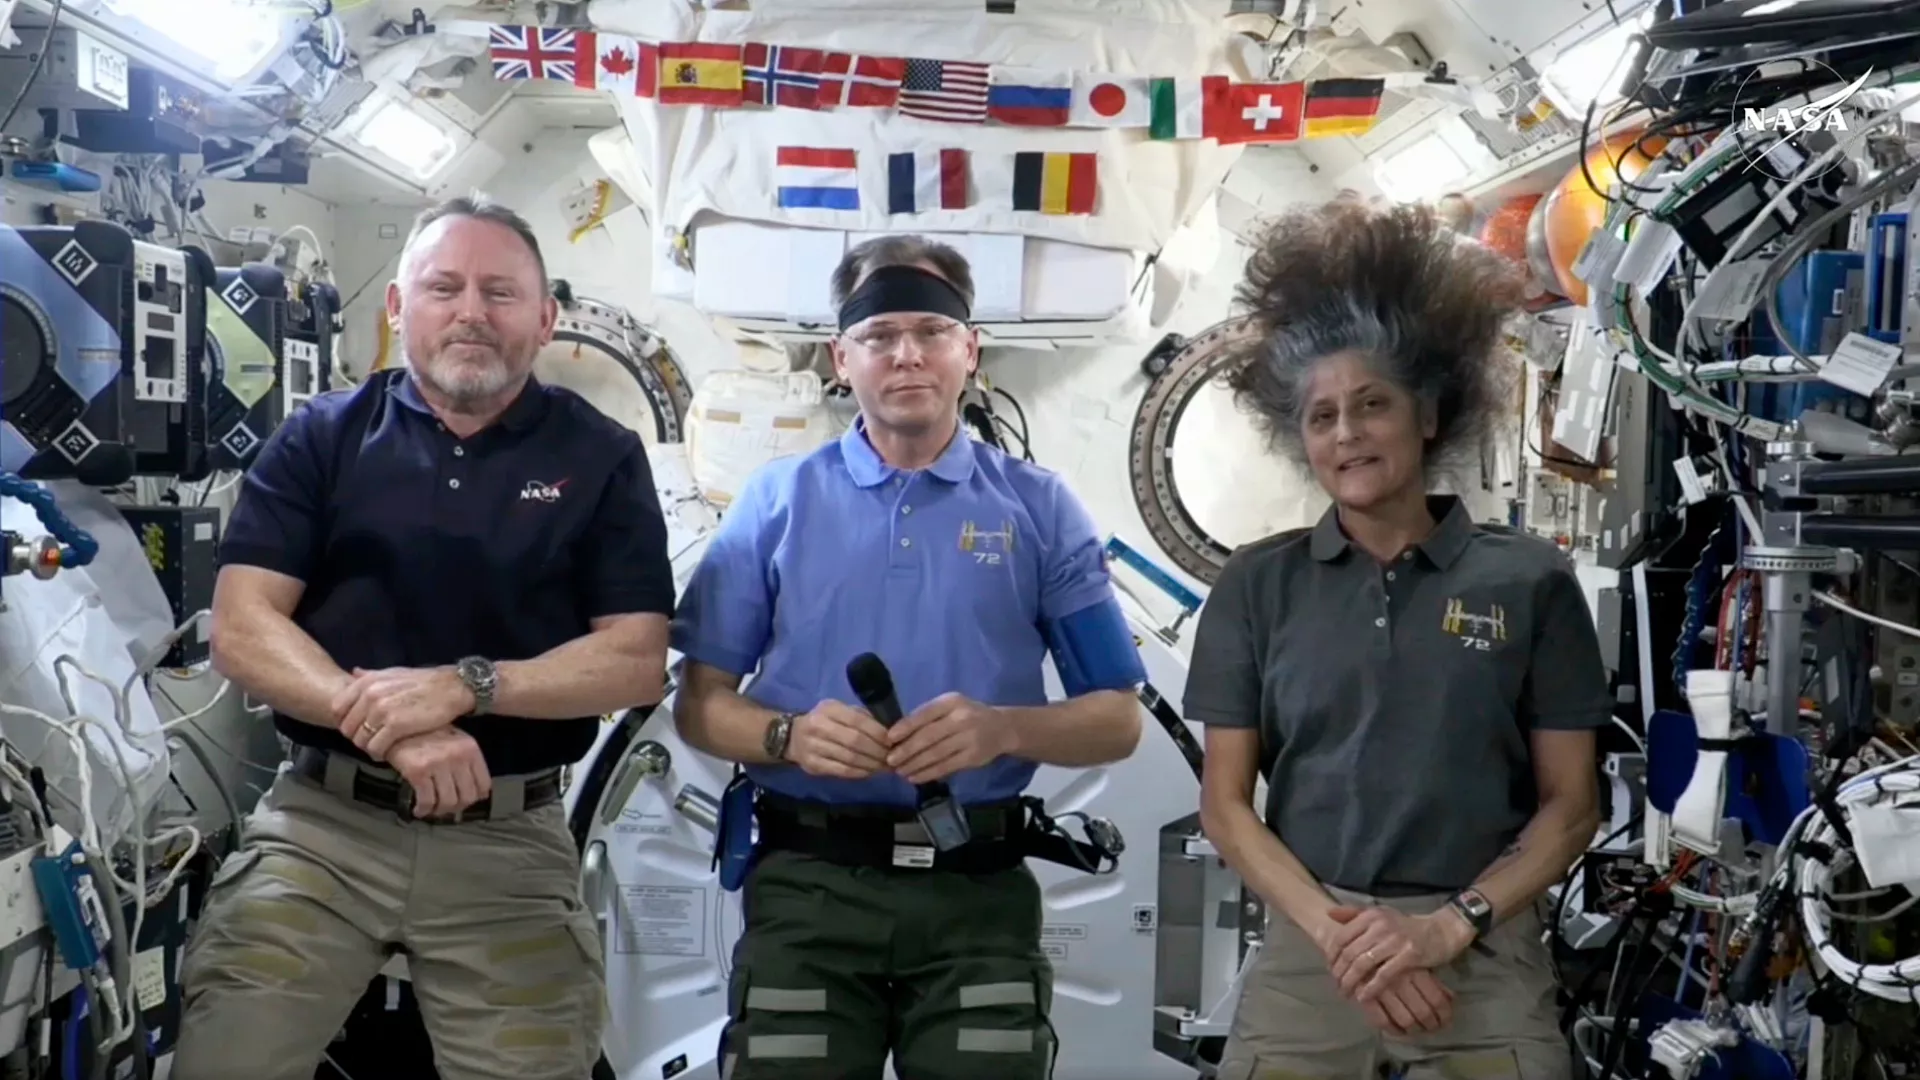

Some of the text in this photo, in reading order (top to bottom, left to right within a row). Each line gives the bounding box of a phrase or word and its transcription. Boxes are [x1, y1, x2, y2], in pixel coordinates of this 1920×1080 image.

[520, 487, 561, 501] NASA
[973, 551, 1001, 565] 72
[1460, 635, 1491, 652] 72
